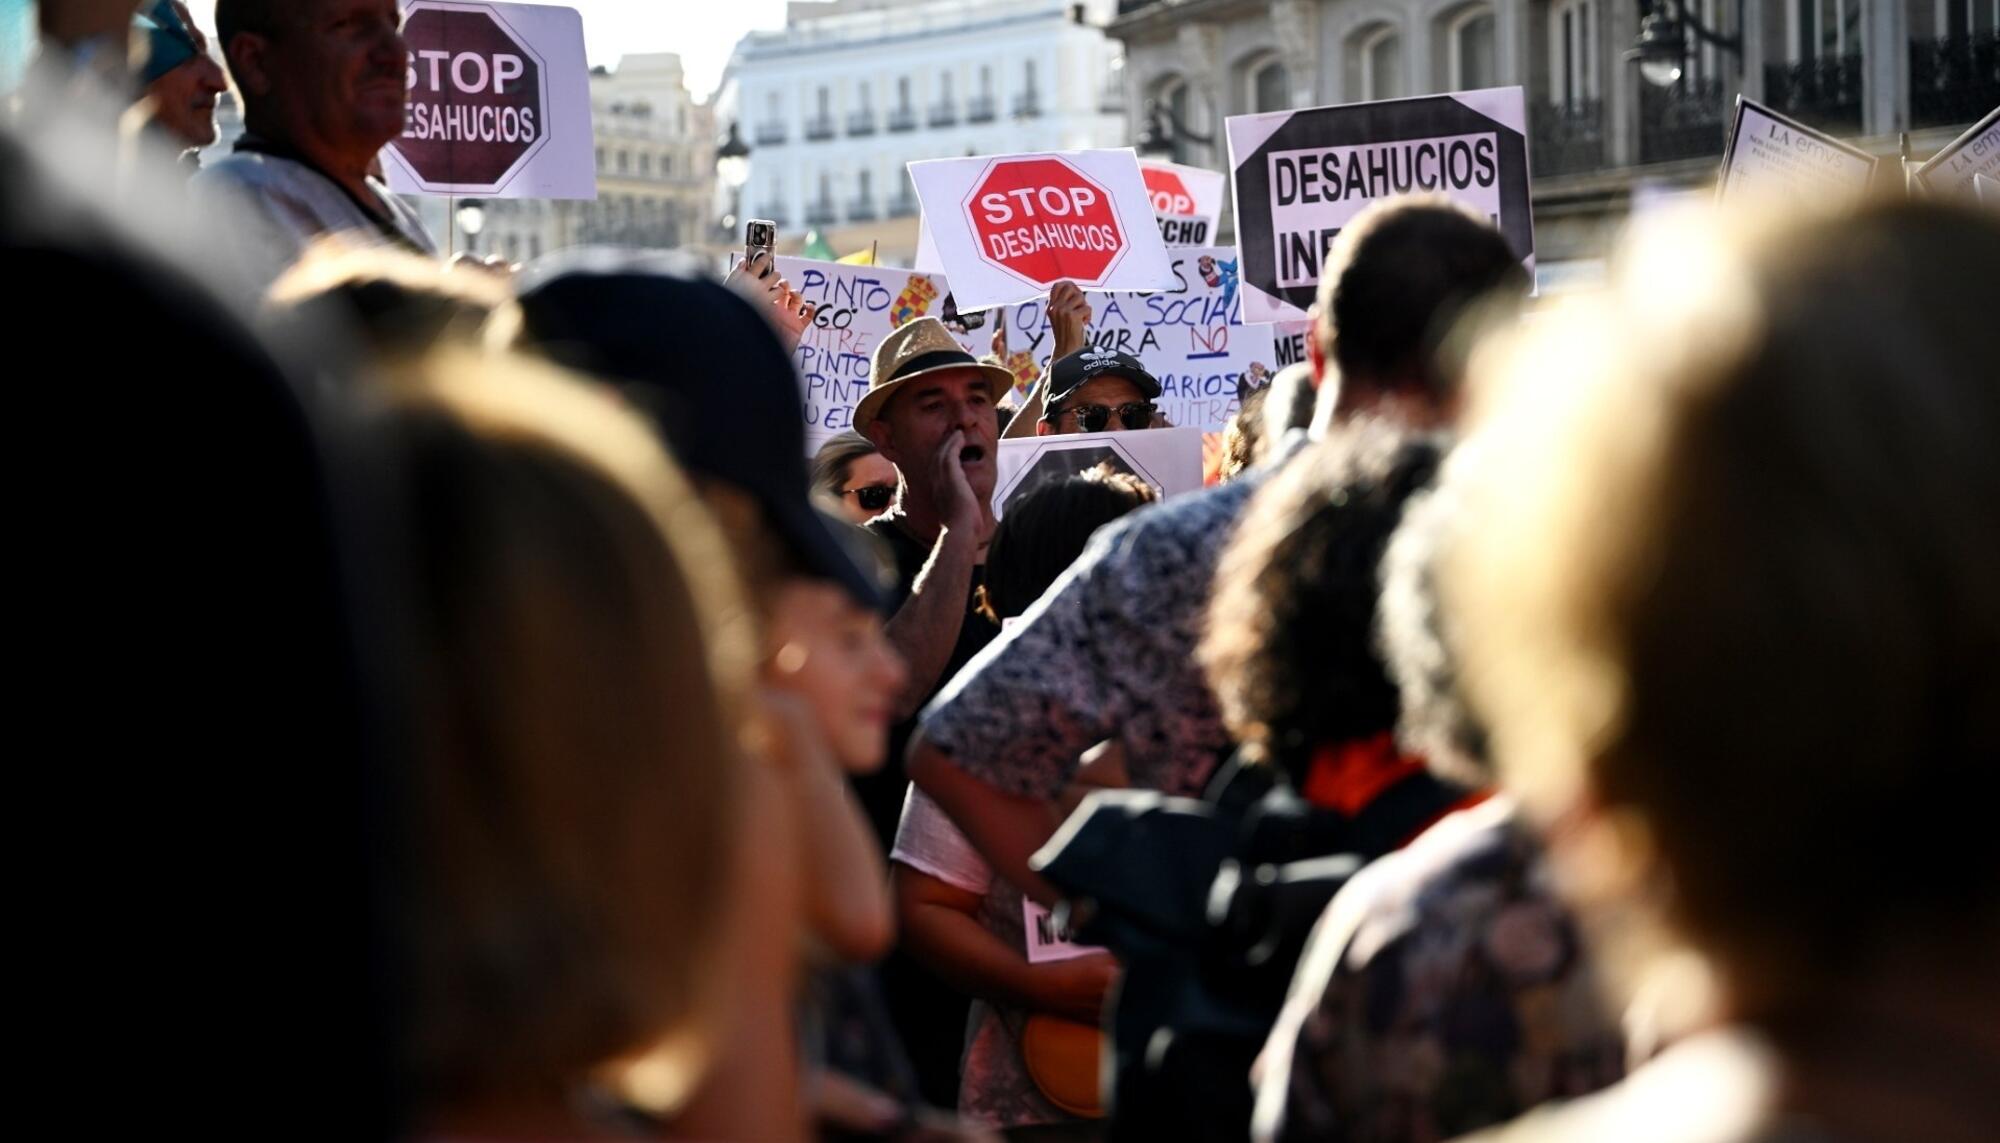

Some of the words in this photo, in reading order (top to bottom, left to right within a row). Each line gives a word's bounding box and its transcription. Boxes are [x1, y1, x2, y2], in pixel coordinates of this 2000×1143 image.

[401, 102, 535, 143] ESAHUCIOS
[1972, 126, 2000, 157] em
[1275, 138, 1496, 207] DESAHUCIOS
[981, 185, 1097, 225] STOP
[988, 222, 1118, 261] DESAHUCIOS
[1191, 325, 1228, 353] NO
